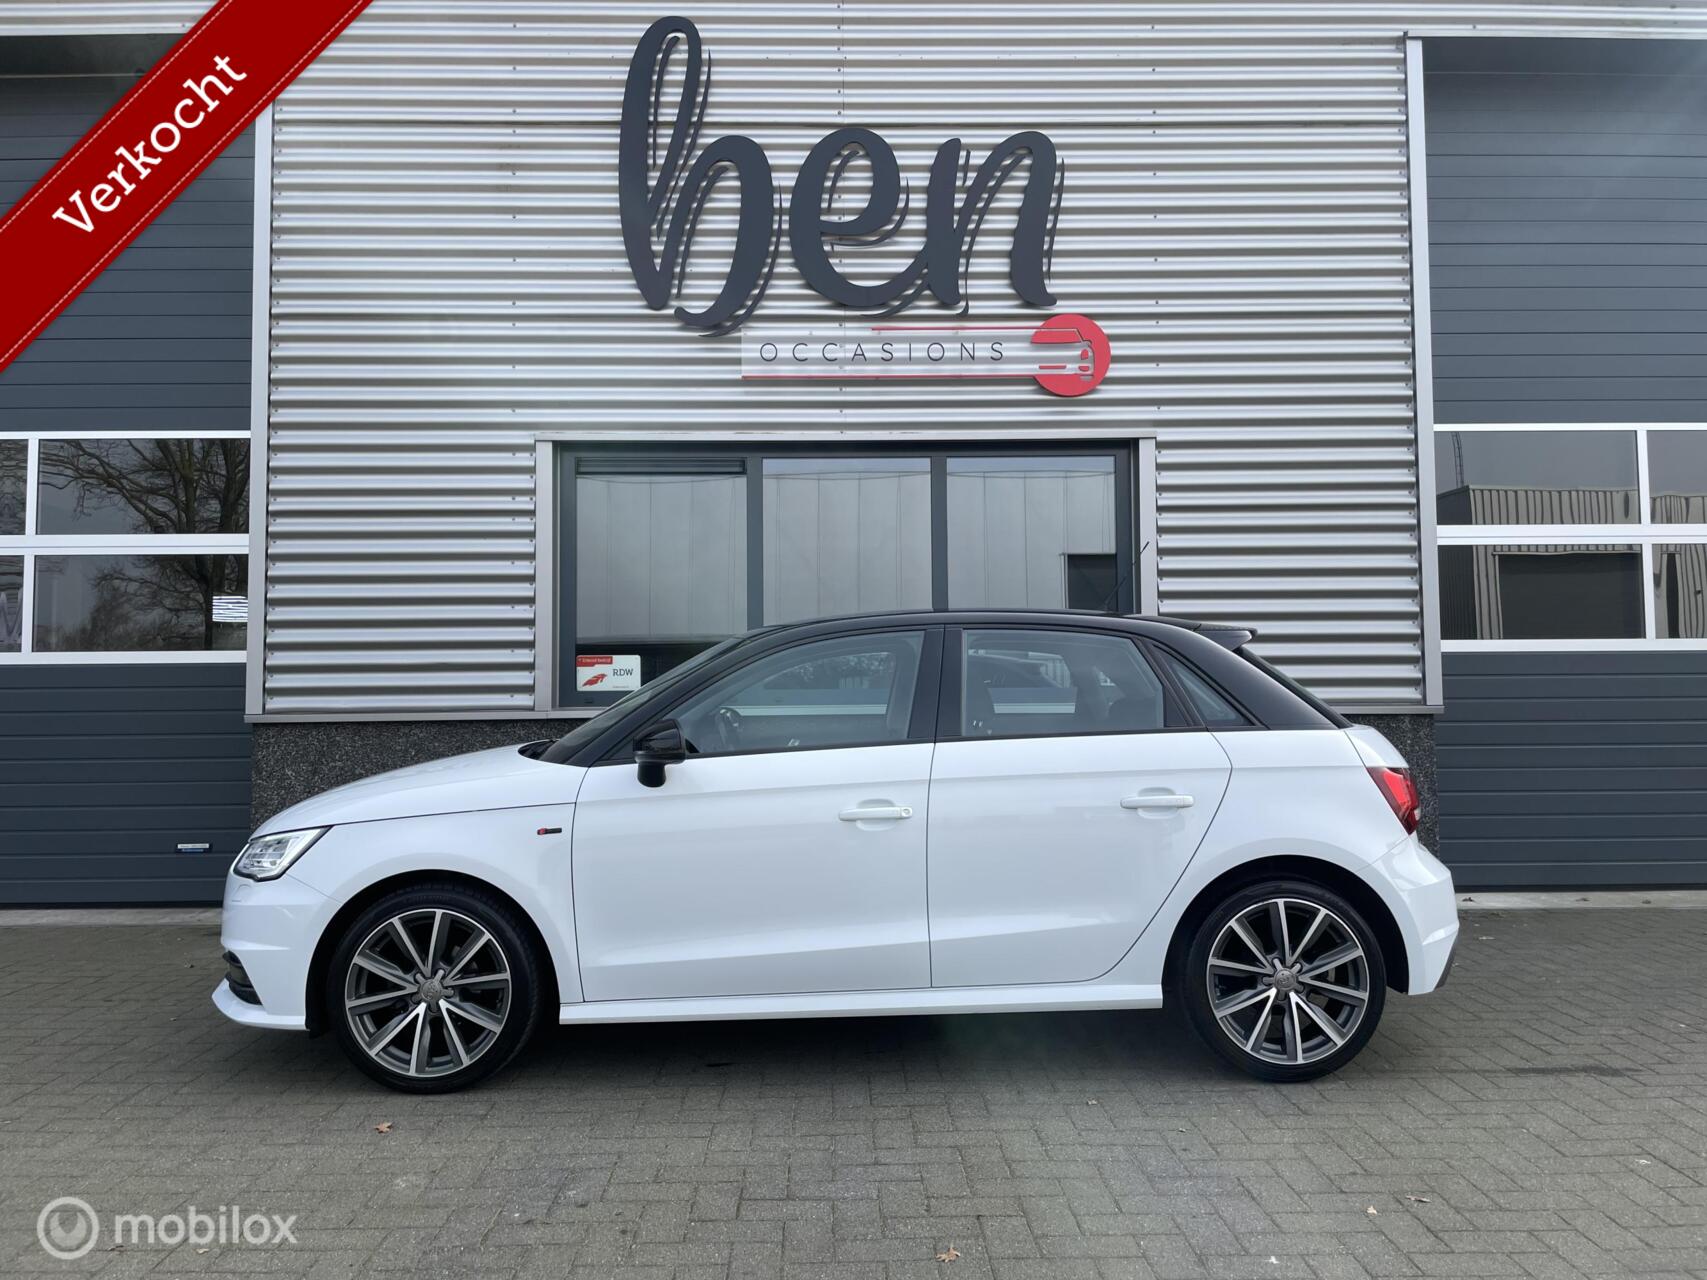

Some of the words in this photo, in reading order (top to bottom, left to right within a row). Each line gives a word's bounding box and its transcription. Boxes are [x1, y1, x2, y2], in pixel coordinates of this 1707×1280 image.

[618, 15, 1062, 335] ben
[759, 341, 1004, 362] OCCASIONS
[612, 668, 634, 677] RDW
